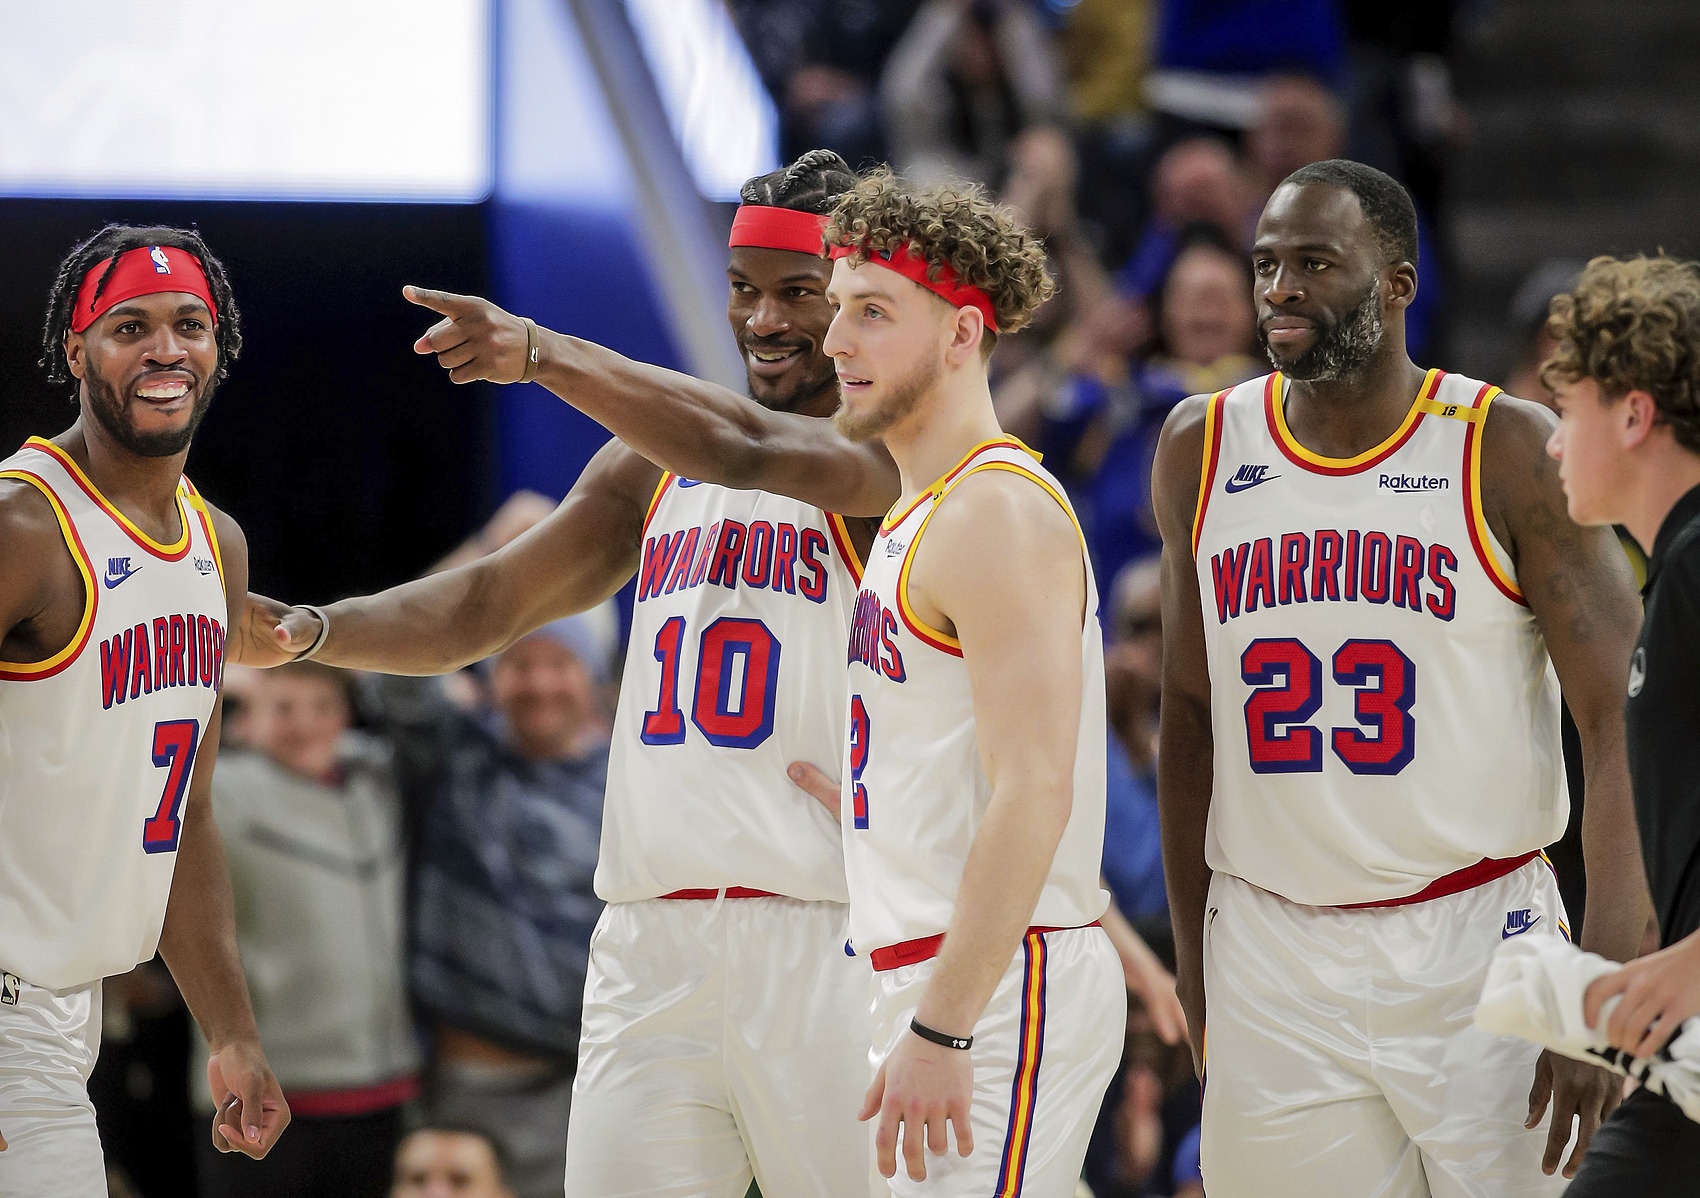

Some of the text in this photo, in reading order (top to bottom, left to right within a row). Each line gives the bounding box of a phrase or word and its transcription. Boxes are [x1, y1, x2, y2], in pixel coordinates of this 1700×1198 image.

[1441, 406, 1458, 416] 16
[1234, 464, 1269, 482] NIKE
[1379, 474, 1449, 490] Rakuten
[108, 557, 131, 575] NIKE
[1211, 529, 1458, 625] WARRIORS
[99, 613, 224, 710] WARRIOR
[641, 616, 781, 749] 10
[1241, 637, 1416, 776] 23
[142, 718, 199, 855] 7
[1507, 908, 1531, 929] NIKE
